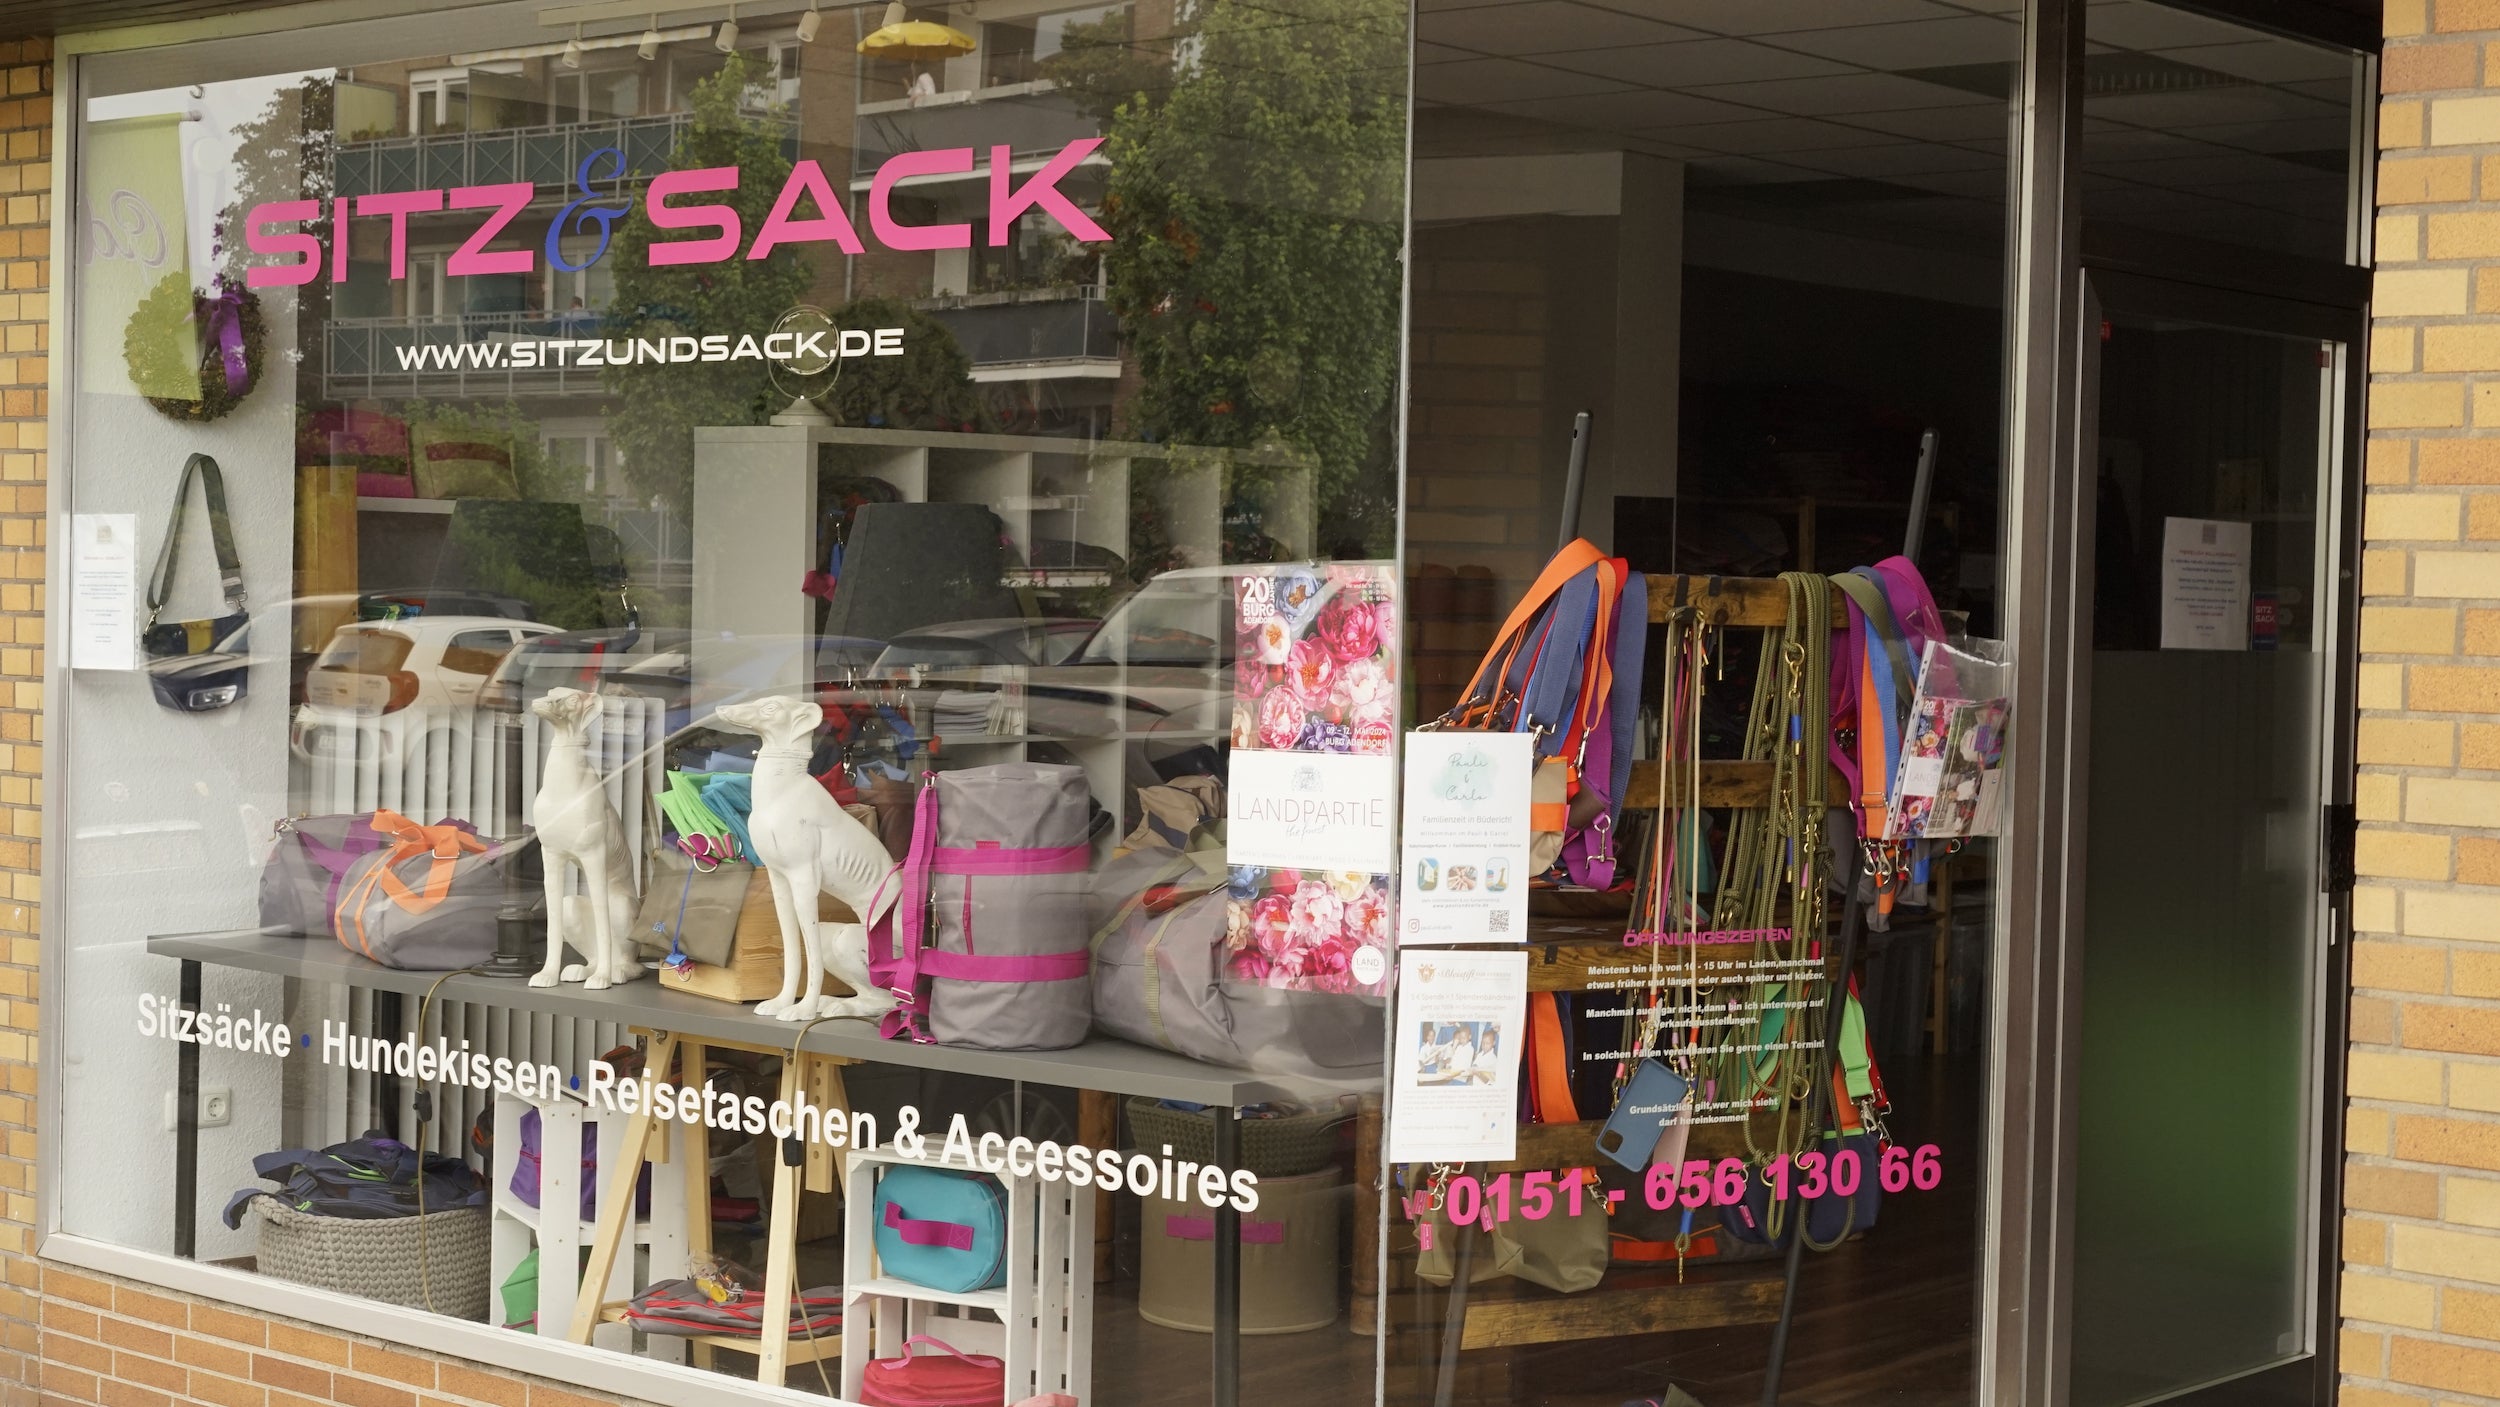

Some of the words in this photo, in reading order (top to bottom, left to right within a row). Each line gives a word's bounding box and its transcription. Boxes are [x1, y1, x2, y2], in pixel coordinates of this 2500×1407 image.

[245, 182, 535, 288] SITZ
[543, 147, 634, 273] &
[648, 137, 1113, 266] SACK
[396, 327, 905, 371] WWW.SITZUNDSACK.DE
[1242, 577, 1270, 603] 20
[1243, 603, 1275, 617] BURG
[2255, 615, 2276, 623] SACK
[1237, 792, 1384, 828] LANDPARTIE
[1422, 815, 1466, 824] Familienzeit
[1623, 927, 1792, 947] ÖFFNUNGSZEITEN
[1356, 957, 1380, 967] LAND
[1588, 964, 1630, 975] Meistens
[1632, 963, 1647, 974] bin
[1665, 963, 1682, 973] von
[1703, 961, 1715, 970] 15
[1717, 960, 1734, 970] Uhr
[1735, 960, 1747, 969] im
[1586, 980, 1615, 990] etwas
[1617, 978, 1646, 988] früher
[1648, 977, 1665, 987] und
[1698, 975, 1719, 985] oder
[1721, 974, 1744, 983] auch
[1745, 973, 1774, 984] später
[1776, 971, 1793, 981] und
[1585, 1007, 1634, 1018] Manchmal
[1661, 1006, 1676, 1017] gar
[1728, 1001, 1742, 1011] bin
[1744, 1001, 1758, 1010] ich
[1760, 1000, 1807, 1010] unterwegs
[1809, 998, 1825, 1008] auf
[1582, 1052, 1592, 1061] In
[1594, 1050, 1631, 1060] solchen
[1719, 1044, 1734, 1054] Sie
[1736, 1043, 1763, 1054] gerne
[1764, 1041, 1790, 1051] einen
[1791, 1039, 1825, 1050] Termin!
[136, 992, 292, 1058] Sitzsäcke
[322, 1019, 562, 1101] Hundekissen
[588, 1059, 878, 1152] Reisetaschen
[893, 1105, 929, 1161] &
[939, 1113, 1260, 1213] Accessoires
[1629, 1102, 1693, 1115] Grundsätzlich
[1731, 1098, 1754, 1109] mich
[1755, 1097, 1779, 1107] sieht
[1658, 1117, 1678, 1127] darf
[1680, 1113, 1750, 1125] hereinkommen!
[1447, 1167, 1583, 1226] 0151
[1644, 1157, 1746, 1211] 656
[1765, 1149, 1862, 1201] 130
[1879, 1143, 1943, 1194] 66
